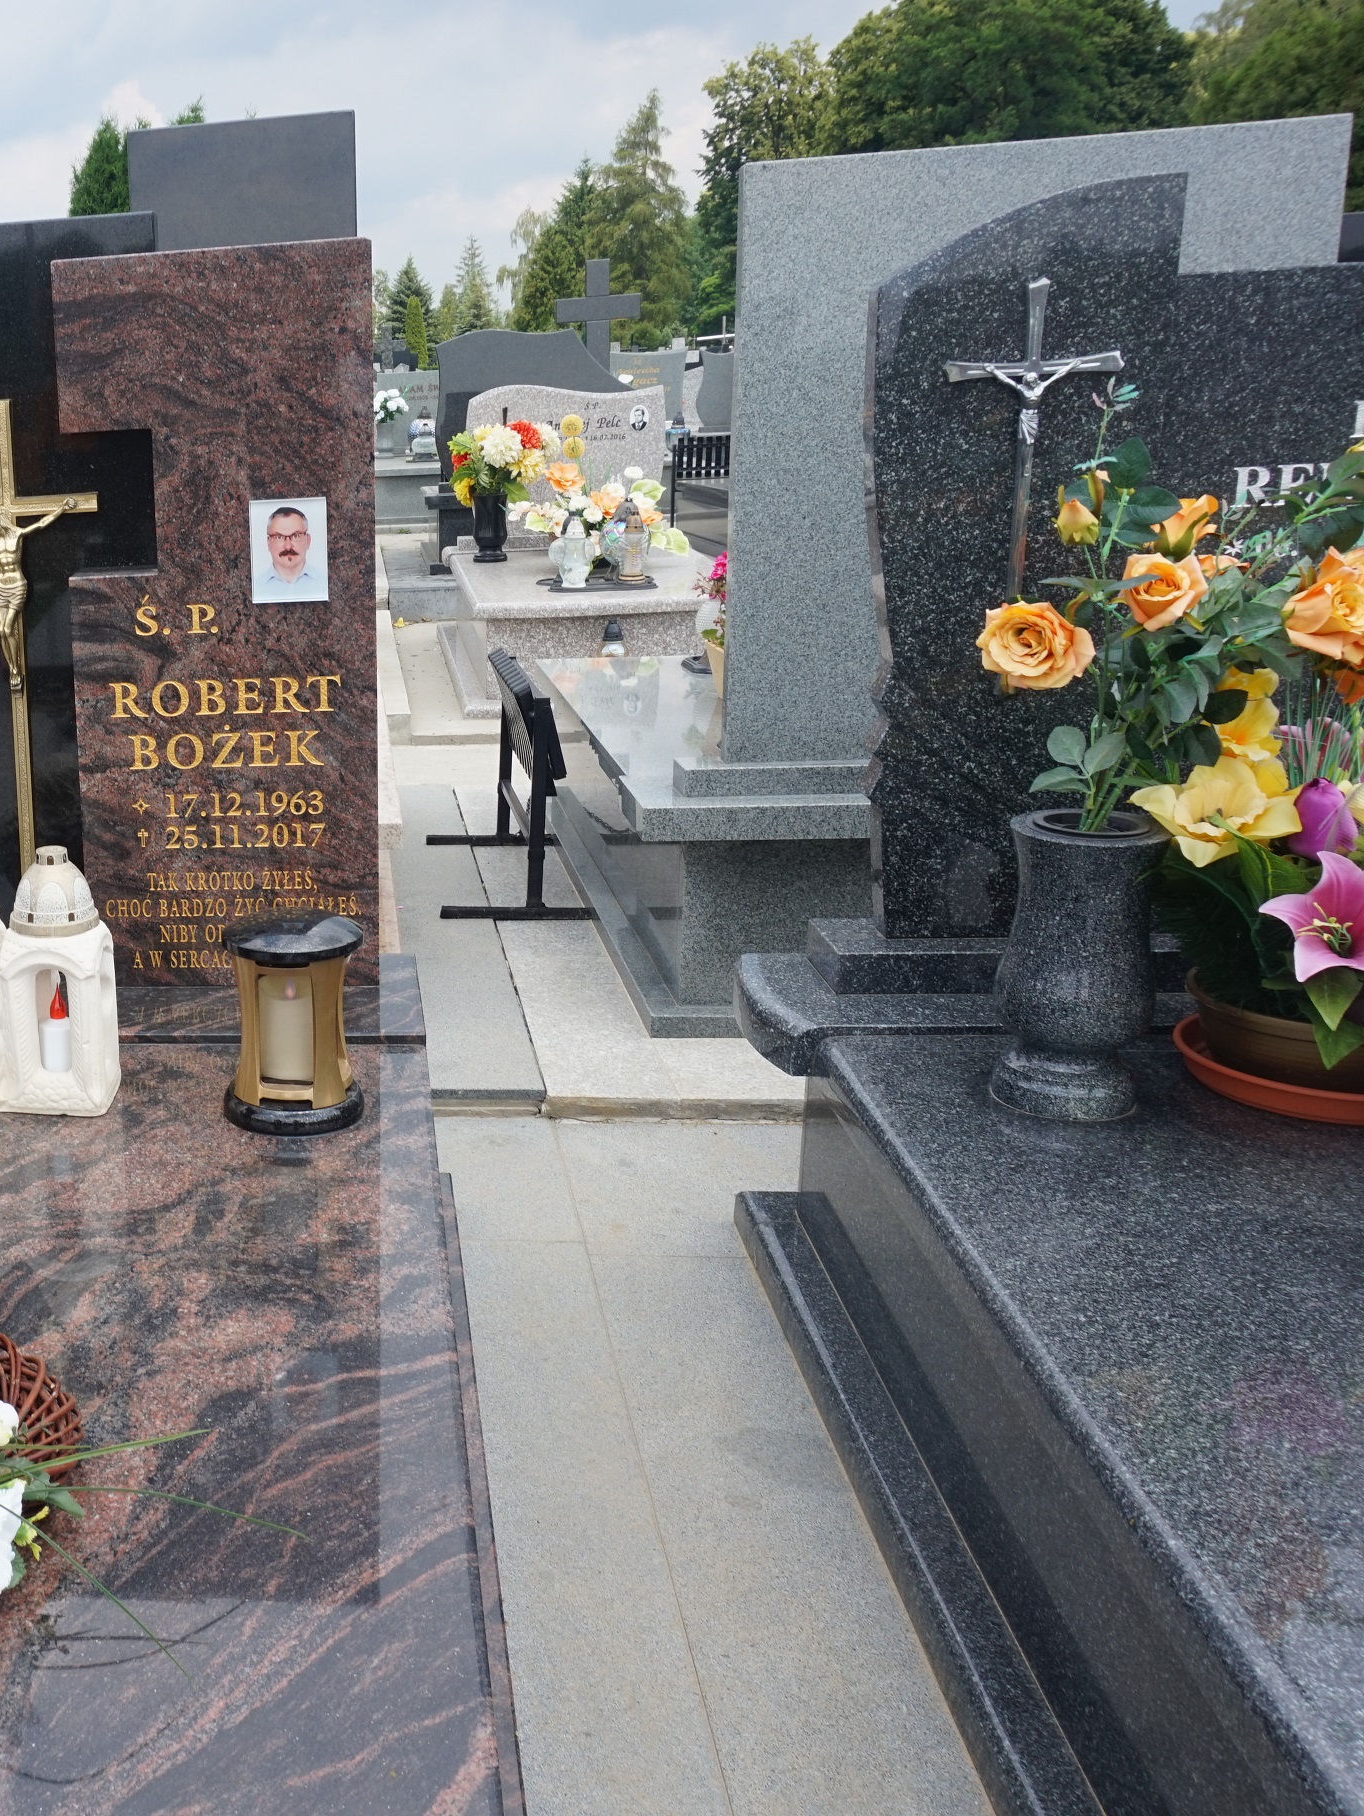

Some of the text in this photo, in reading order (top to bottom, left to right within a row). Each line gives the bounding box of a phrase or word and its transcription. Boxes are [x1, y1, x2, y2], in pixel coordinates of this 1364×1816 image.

[134, 594, 219, 636] Ś. P.
[108, 674, 342, 718] ROBERT
[128, 724, 325, 770] BOŻEK
[165, 790, 325, 818] 17.12.1963
[164, 823, 326, 849] 25.11.2017
[147, 867, 318, 893] TAK KRÓTKO ŻYŁEŚ,
[106, 893, 152, 918] CHOĆ
[159, 900, 227, 917] BARDZO
[160, 924, 198, 943] NIBY
[133, 952, 144, 969] A
[149, 951, 163, 968] W
